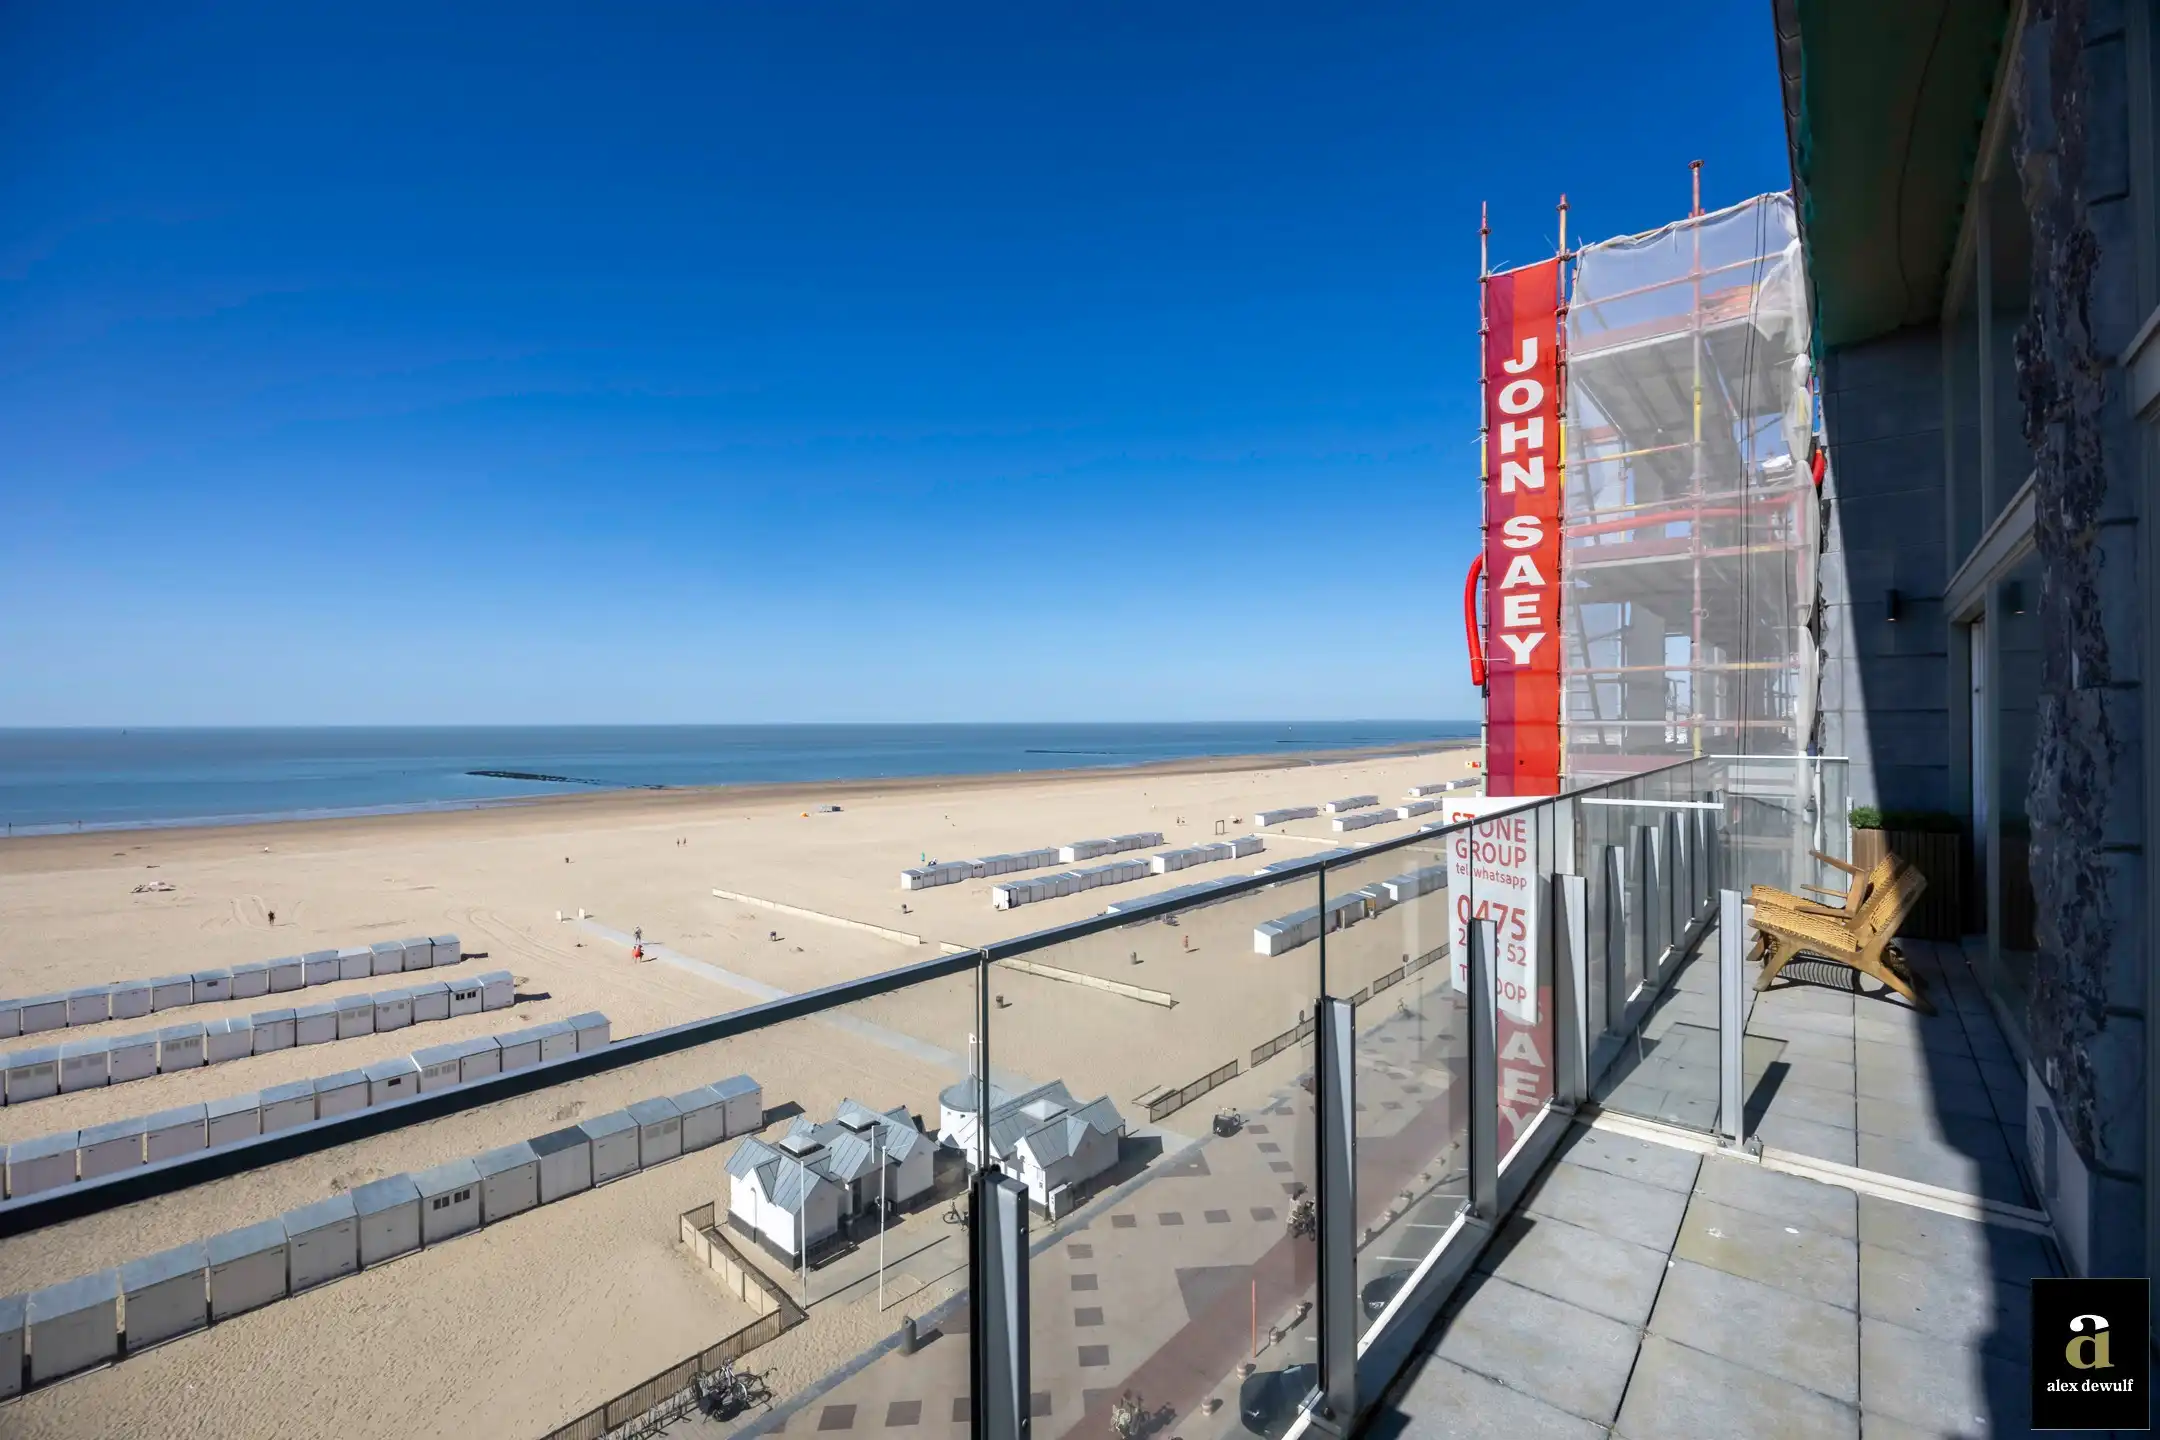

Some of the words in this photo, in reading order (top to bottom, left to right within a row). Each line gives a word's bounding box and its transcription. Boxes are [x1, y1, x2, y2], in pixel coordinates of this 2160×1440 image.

[1498, 337, 1545, 493] JOHN
[1500, 515, 1546, 665] SAEY
[1455, 838, 1527, 868] GROUP
[1474, 866, 1527, 891] whatsapp
[1507, 943, 1527, 967] 52
